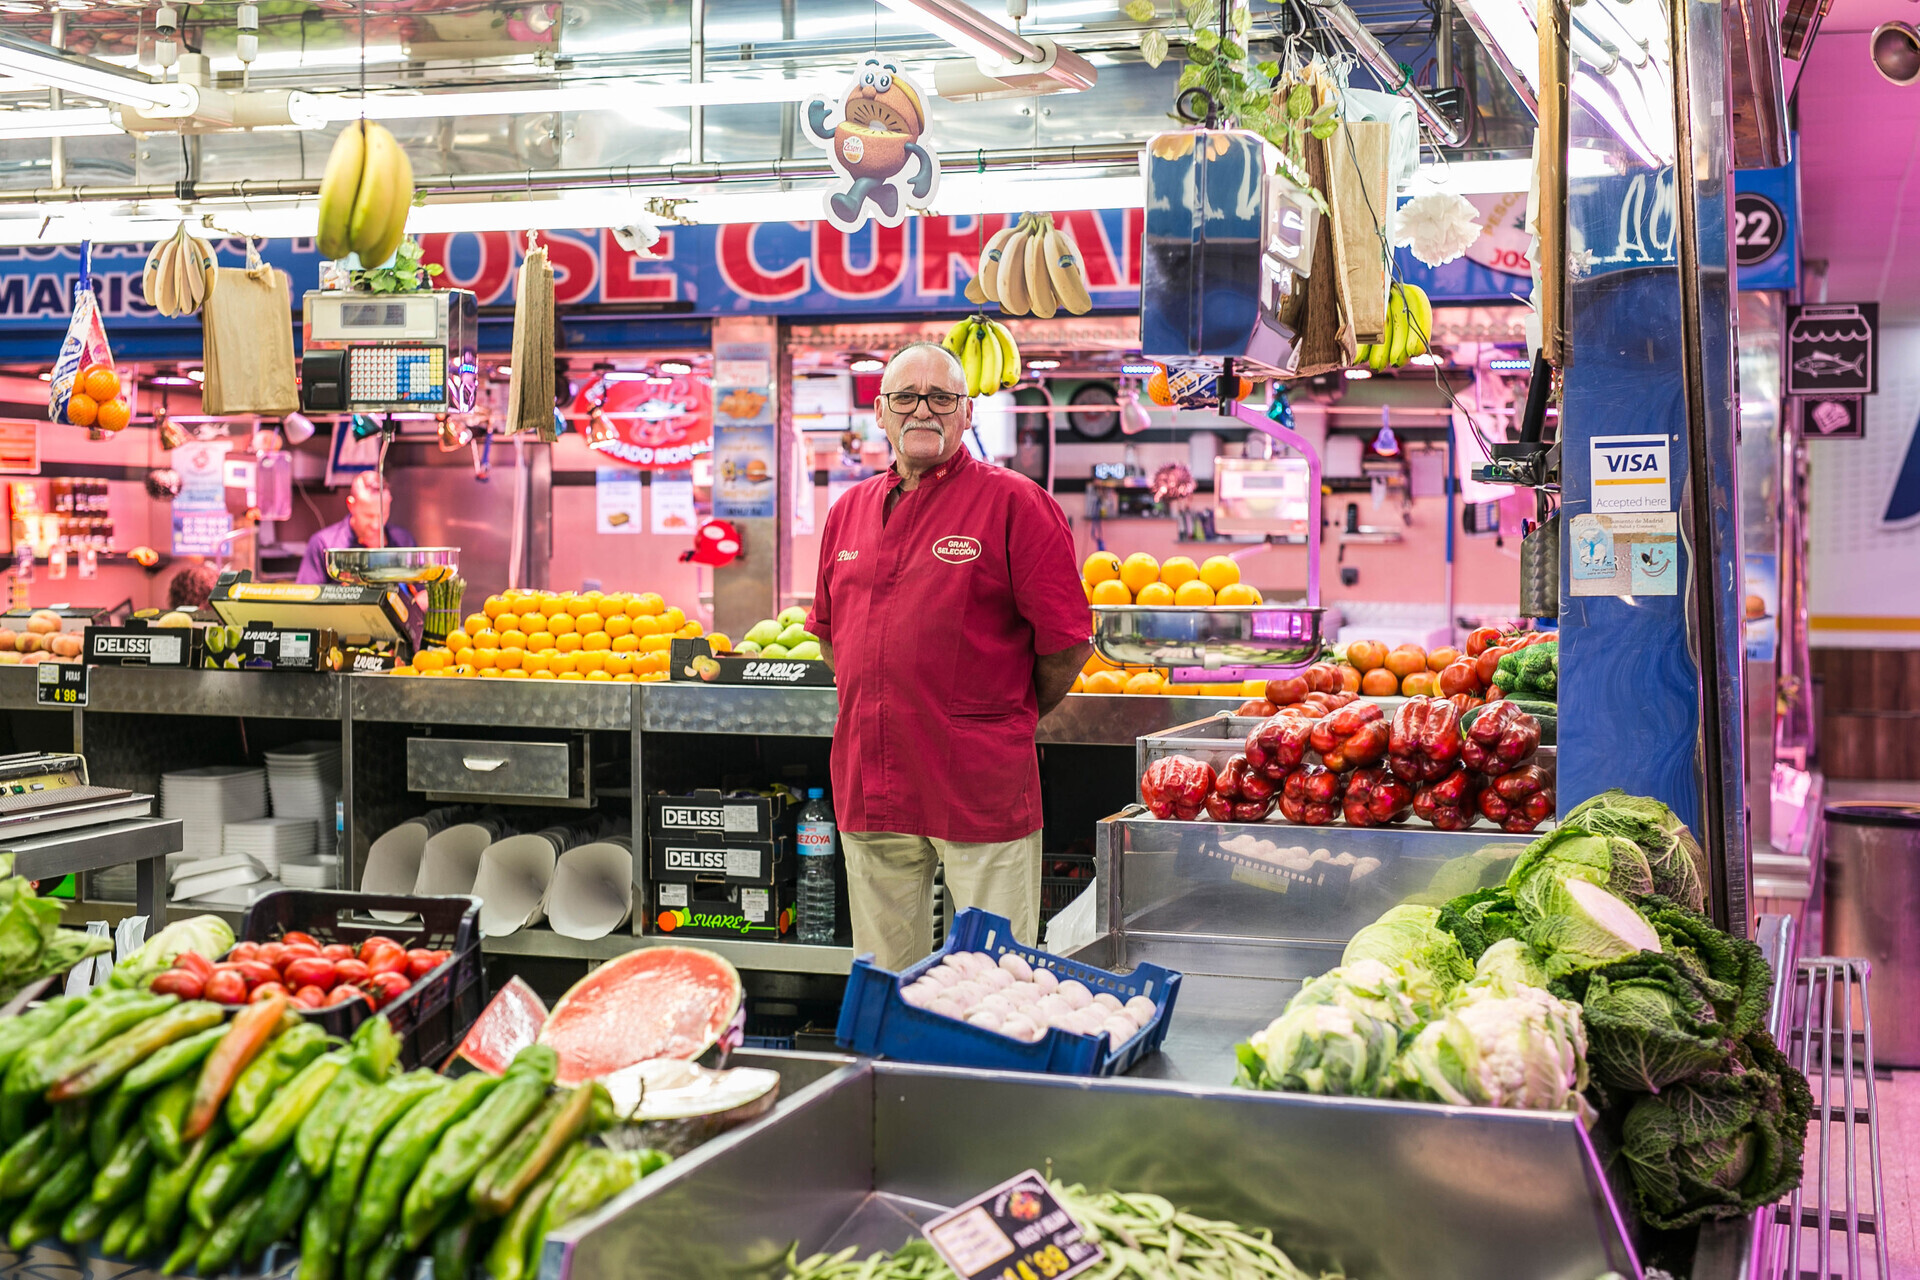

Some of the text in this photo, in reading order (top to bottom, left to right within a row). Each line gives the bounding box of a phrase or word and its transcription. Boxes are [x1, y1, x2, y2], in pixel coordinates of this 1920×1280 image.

[415, 212, 1145, 304] OSE CURA
[1489, 247, 1531, 270] JOS
[1601, 453, 1658, 473] VISA
[1596, 497, 1667, 510] Accepted here
[937, 546, 977, 556] SELECCIÓN
[947, 540, 969, 548] GRAN
[836, 550, 859, 561] Paco
[97, 638, 151, 653] DELISSI
[65, 670, 81, 682] PERAS
[665, 810, 724, 826] DELISSI
[669, 852, 728, 868] DELISSI
